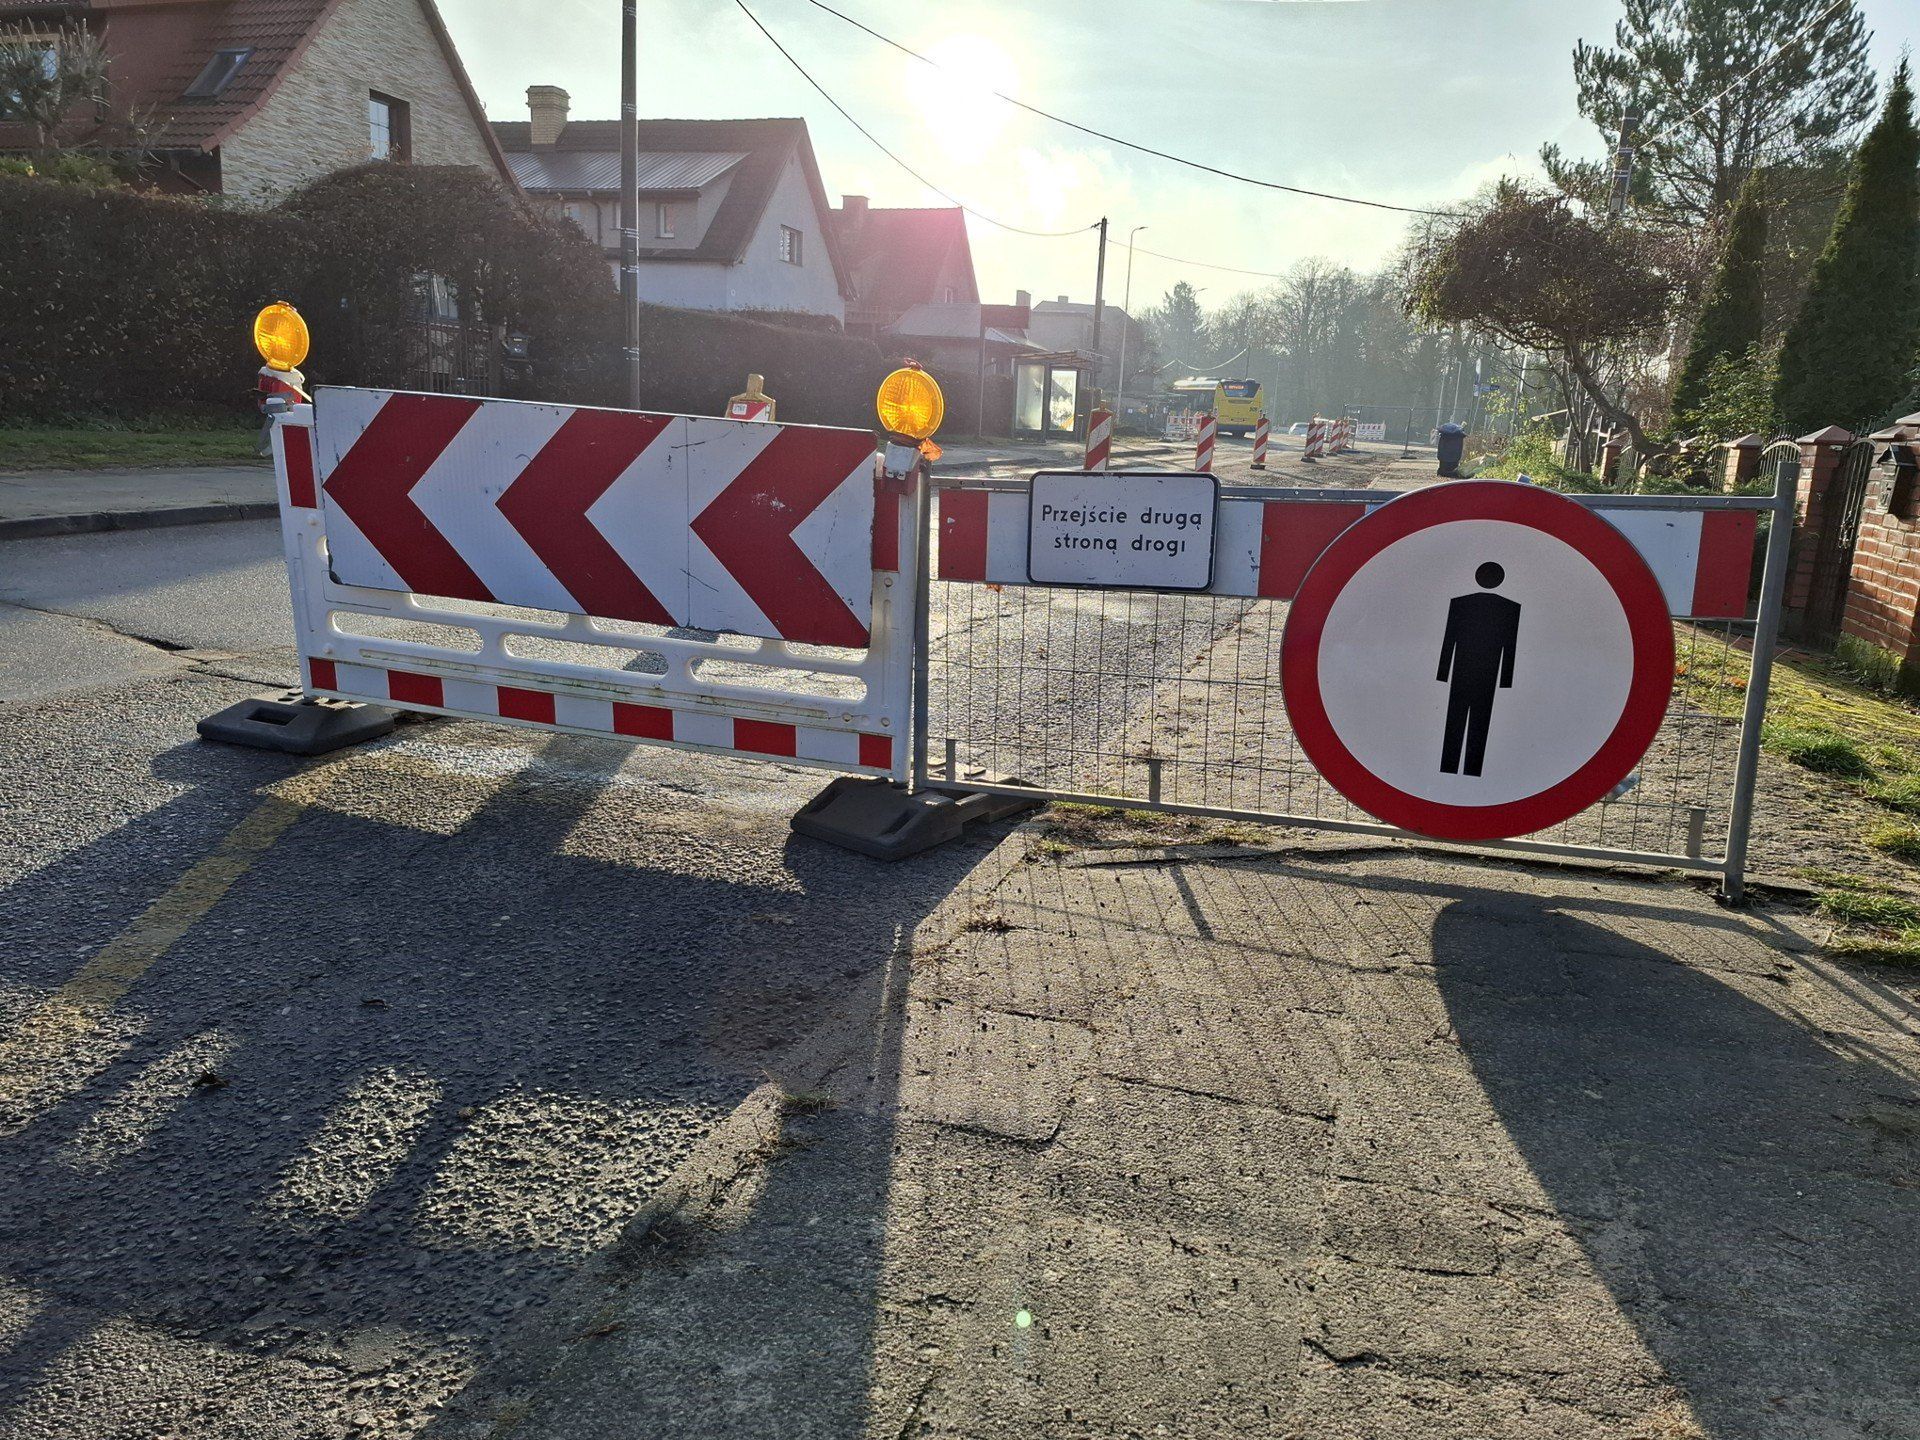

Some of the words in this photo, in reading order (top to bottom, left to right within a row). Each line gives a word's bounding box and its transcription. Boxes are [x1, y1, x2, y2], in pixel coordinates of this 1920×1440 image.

[1042, 504, 1127, 527] Przejście
[1140, 507, 1202, 531] drugą
[1054, 532, 1117, 555] stroną
[1131, 534, 1186, 557] drogi
